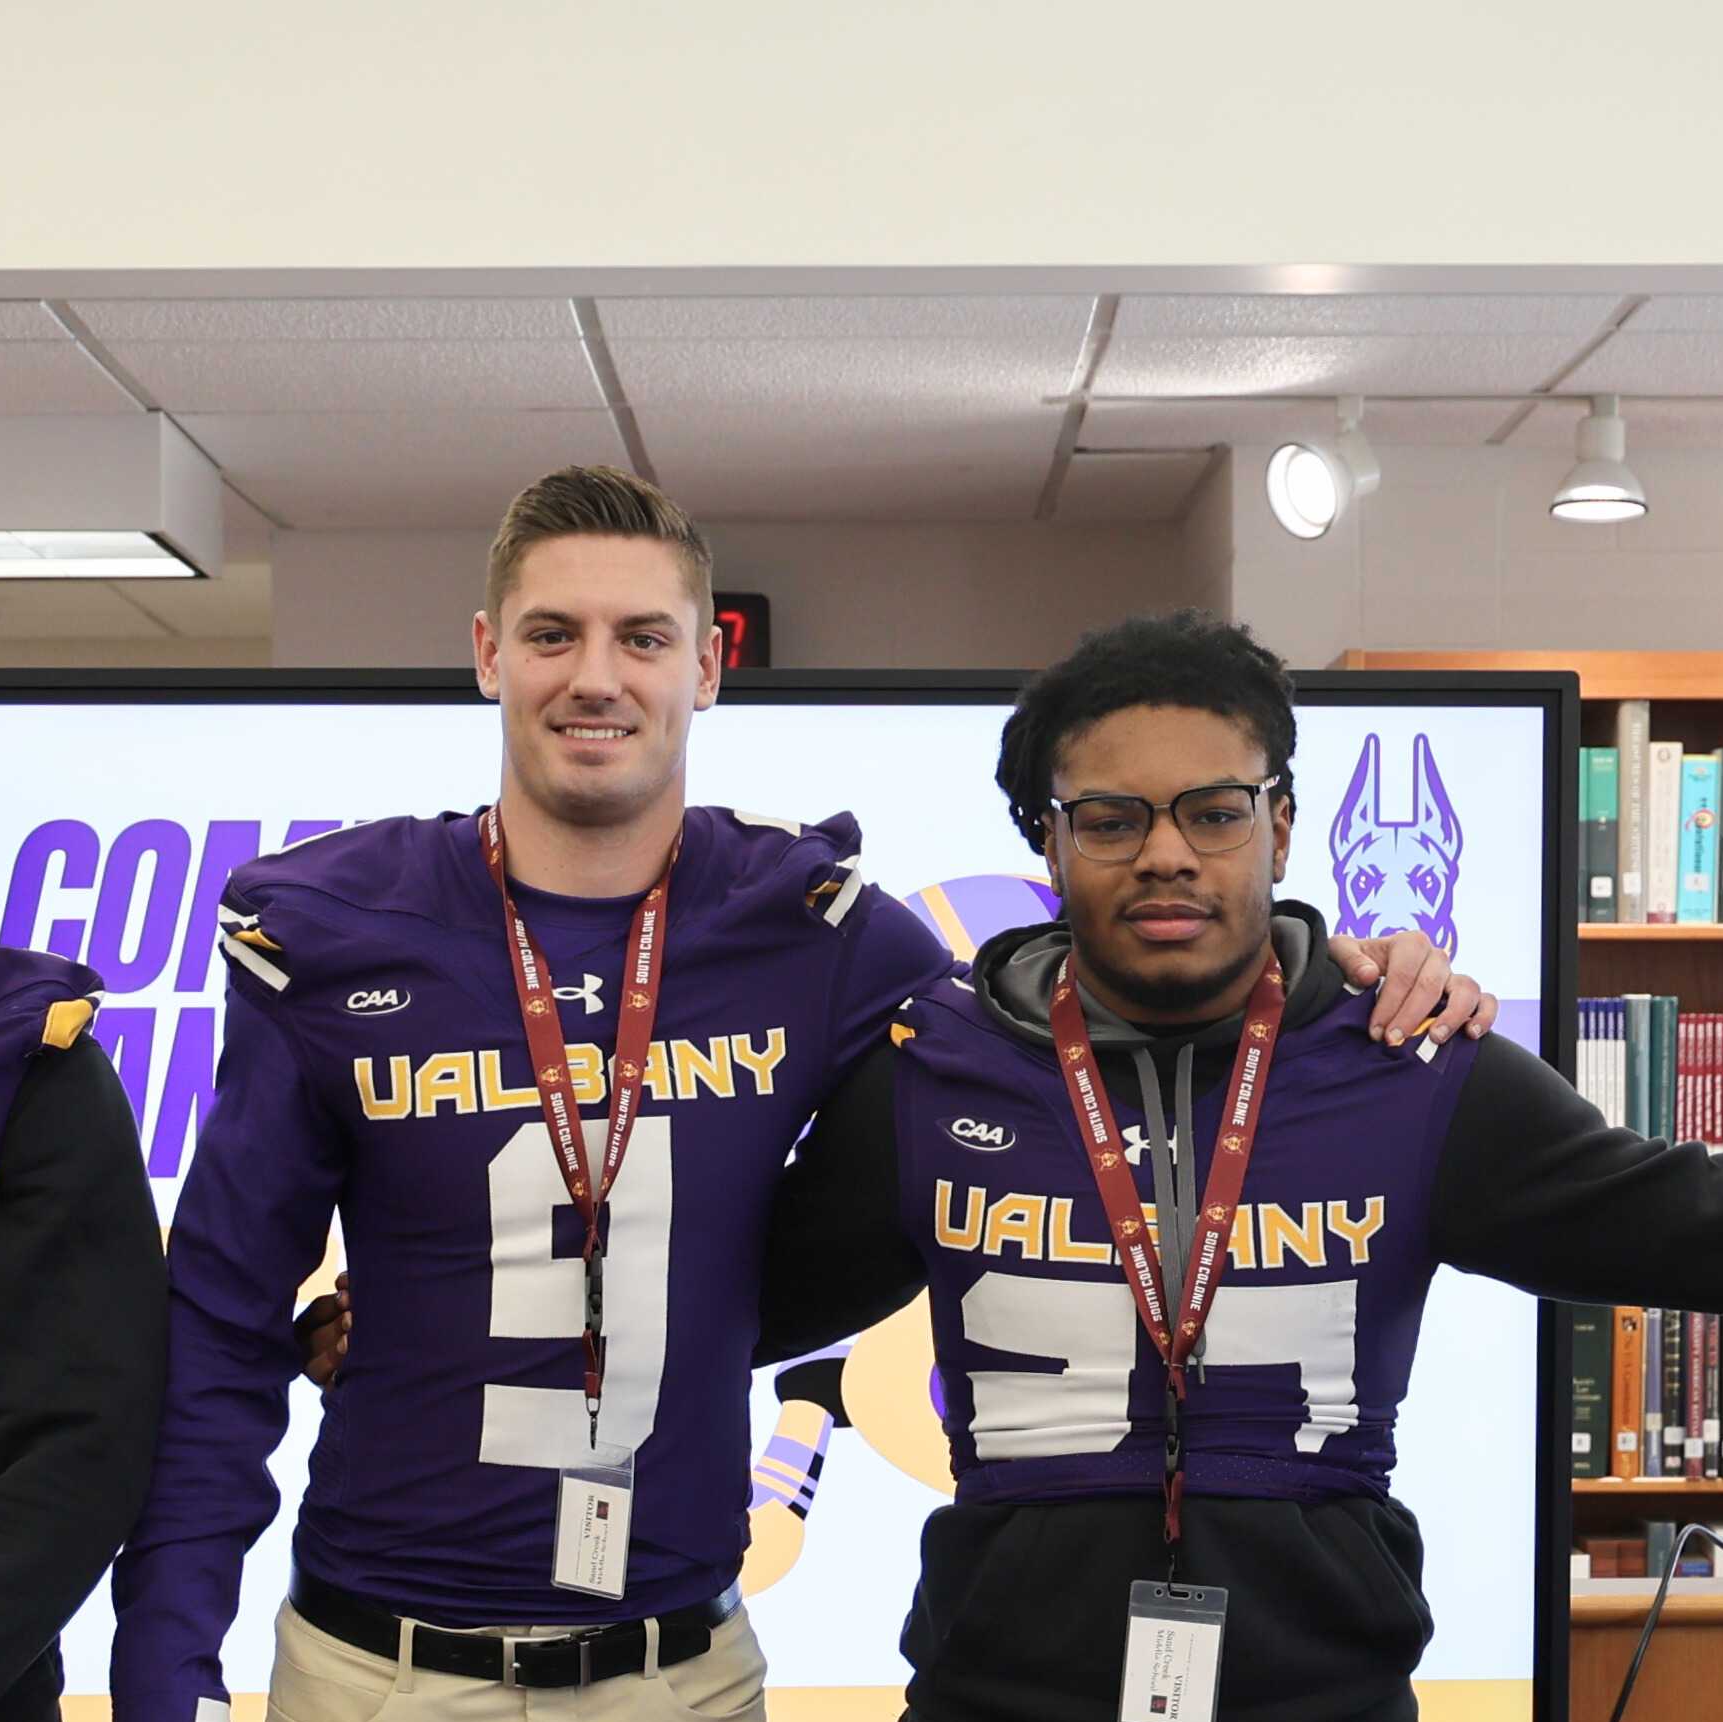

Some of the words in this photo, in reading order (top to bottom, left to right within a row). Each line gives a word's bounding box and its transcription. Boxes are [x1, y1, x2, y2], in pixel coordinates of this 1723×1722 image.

[514, 917, 528, 949] SOUTH
[639, 909, 657, 951] COLONIE
[519, 947, 540, 990] COLONIE
[636, 949, 651, 985] SOUTH
[347, 988, 399, 1010] CAA
[353, 1027, 787, 1121] UALBANY
[1242, 1047, 1262, 1084] SOUTH
[550, 1091, 567, 1130] SOUTH
[615, 1086, 632, 1135] COLONIE
[1075, 1067, 1101, 1112] COLONIE
[1232, 1080, 1256, 1127] COLONIE
[949, 1116, 1006, 1146] CAA
[1086, 1108, 1109, 1145] SOUTH
[557, 1126, 580, 1173] COLONIE
[934, 1178, 1385, 1269] UALANY
[1129, 1243, 1154, 1289] COLONIE
[1202, 1231, 1220, 1268] SOUTH
[479, 1115, 674, 1470] 9
[1141, 1284, 1163, 1323] SOUTH
[1190, 1265, 1212, 1312] COLONIE
[1170, 1675, 1184, 1721] VISITOR
